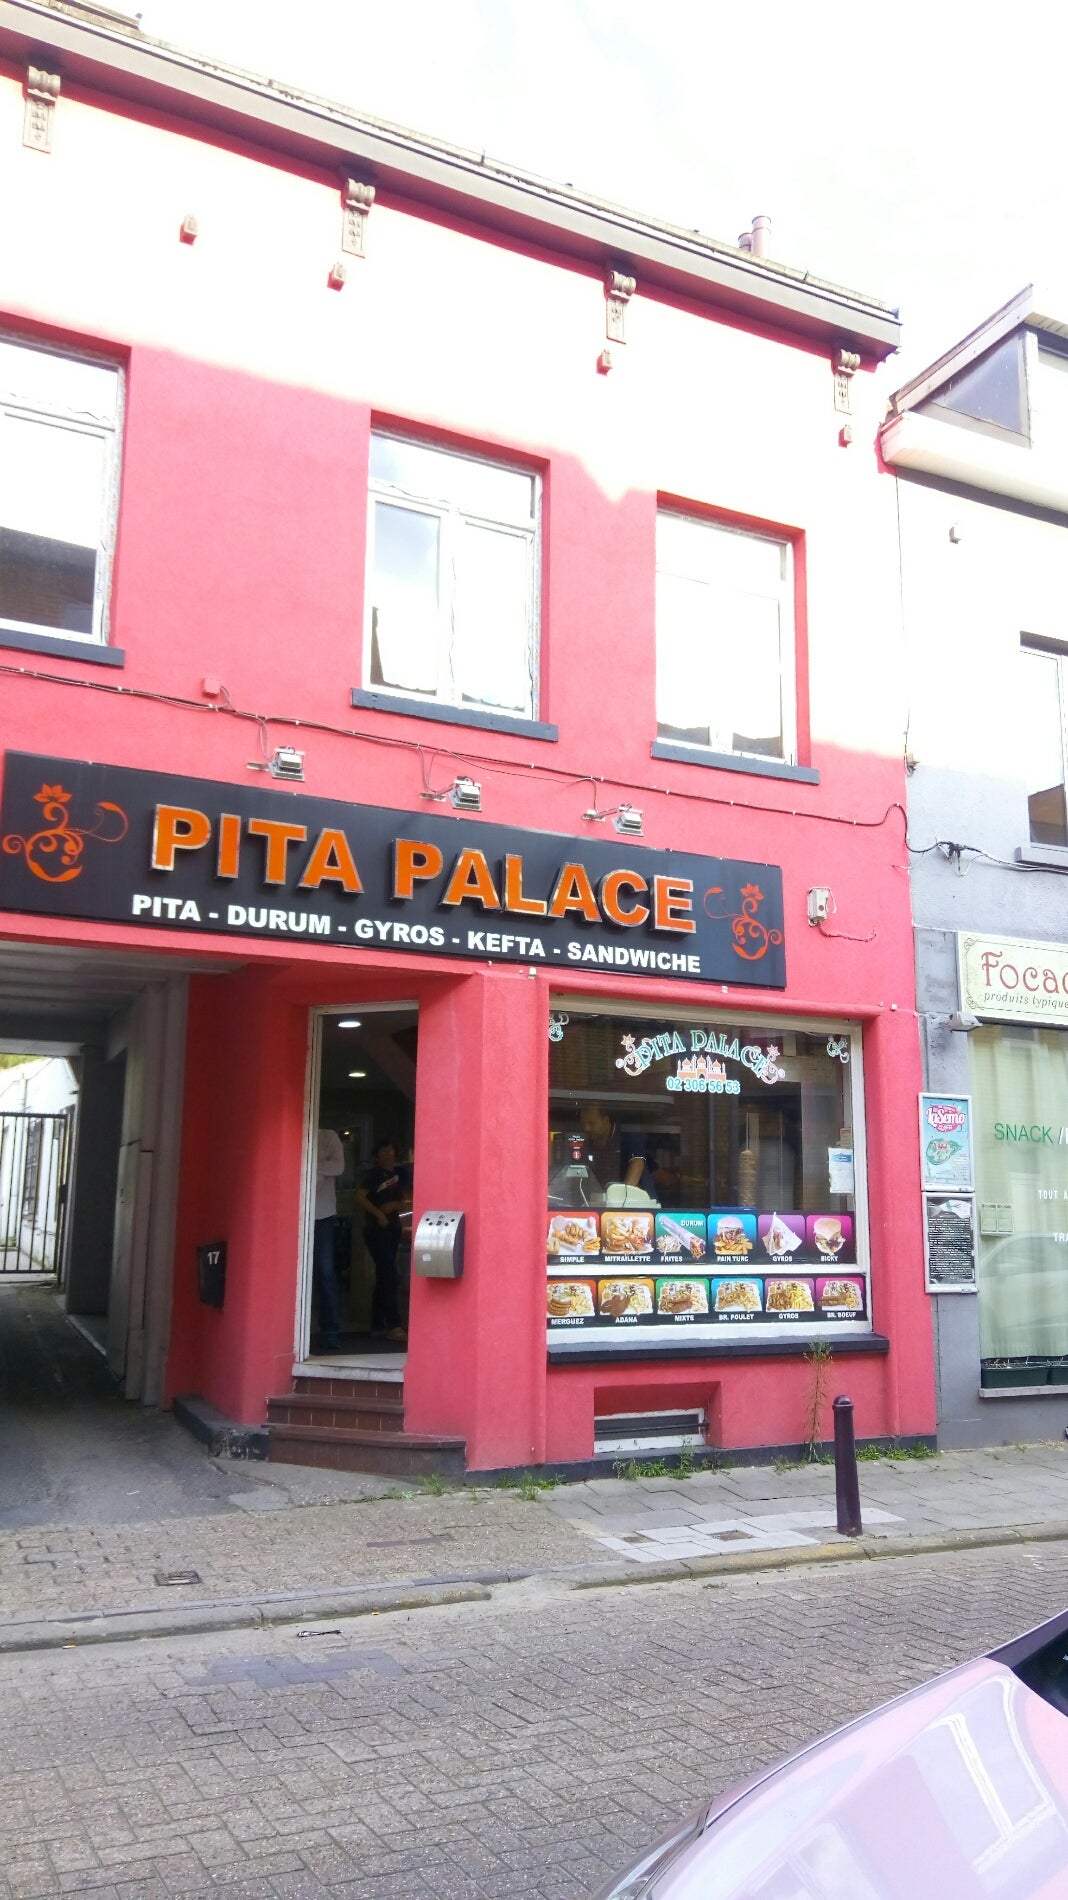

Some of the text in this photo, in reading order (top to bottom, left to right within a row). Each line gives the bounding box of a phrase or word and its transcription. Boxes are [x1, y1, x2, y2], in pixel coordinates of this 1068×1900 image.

[151, 803, 697, 934] PITA PALACE
[131, 893, 202, 922] PITA
[227, 904, 331, 935] DURUM
[354, 919, 445, 946] GYROS
[467, 930, 546, 957] KEFTA
[567, 941, 702, 974] SANDWICHE
[983, 991, 1030, 1004] produits
[635, 1030, 770, 1077] PITA PALACE
[666, 1076, 741, 1094] 02 306 56 53
[994, 1122, 1054, 1144] SNACK
[1038, 1189, 1058, 1200] TOUT
[680, 1219, 704, 1227] DURUM
[207, 1251, 221, 1265] 17
[604, 1255, 651, 1263] MITRAILLETTE
[660, 1255, 683, 1263] FRITES
[551, 1317, 585, 1325] MERGUEZ
[615, 1316, 638, 1324] ADANA
[674, 1314, 695, 1322] MIXTE
